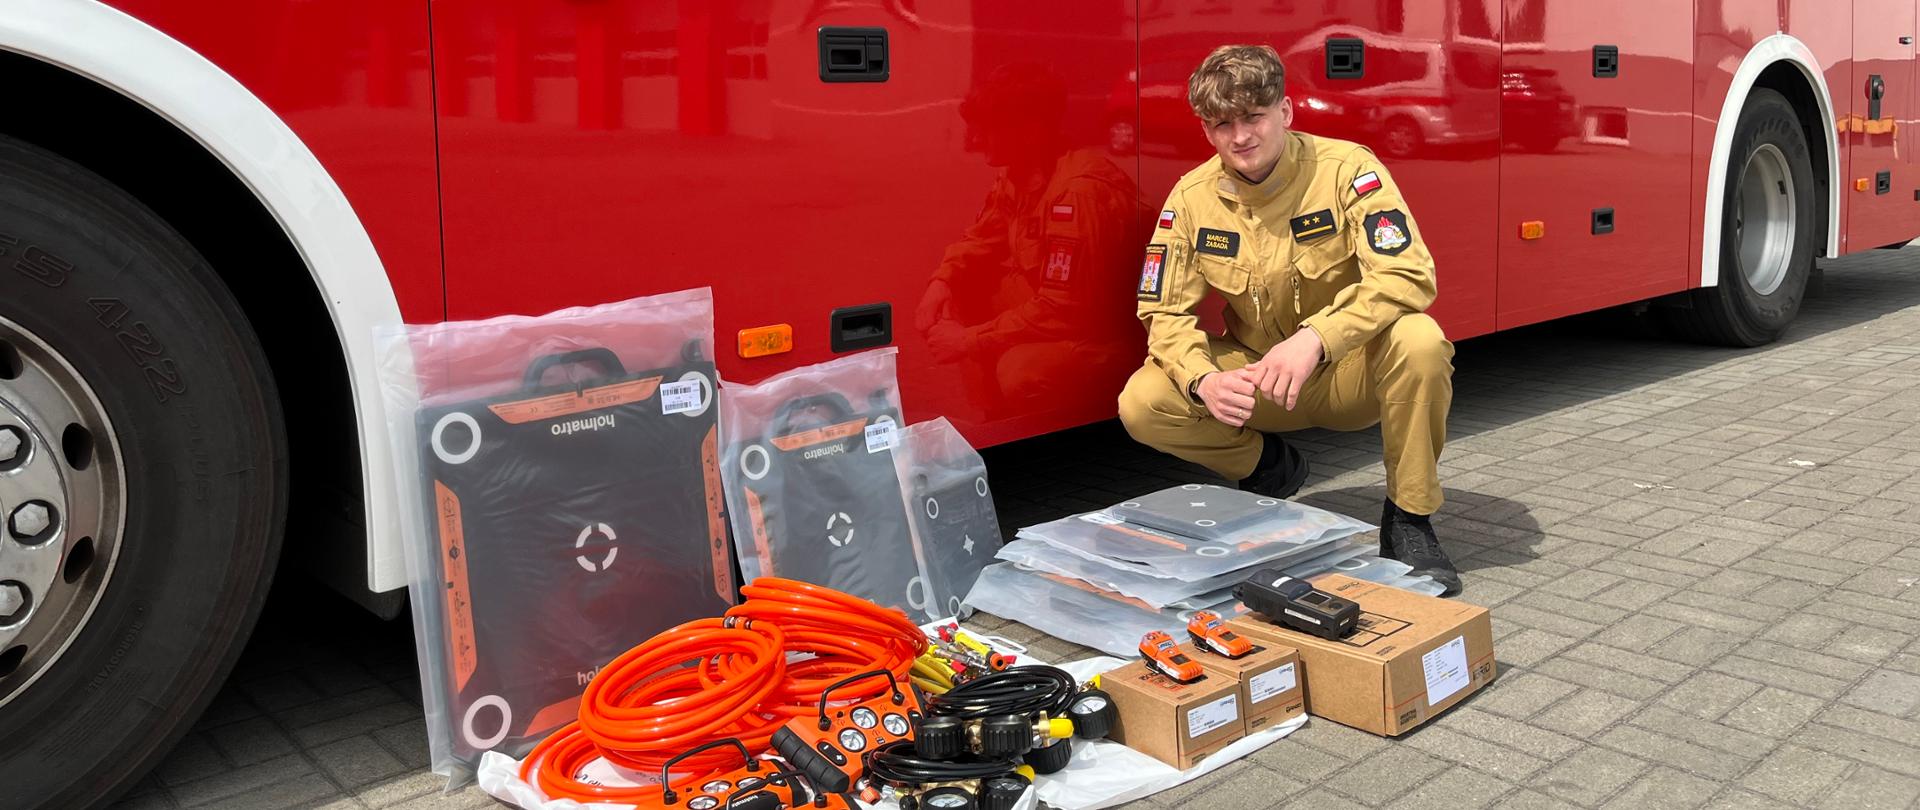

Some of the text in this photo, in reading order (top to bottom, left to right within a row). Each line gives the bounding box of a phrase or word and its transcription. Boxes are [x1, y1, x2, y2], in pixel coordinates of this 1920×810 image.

[1205, 240, 1228, 250] ZASADA
[1206, 233, 1229, 244] MARCEL
[86, 297, 187, 402] 422
[551, 414, 615, 435] holmatro
[803, 443, 845, 460] holmatro
